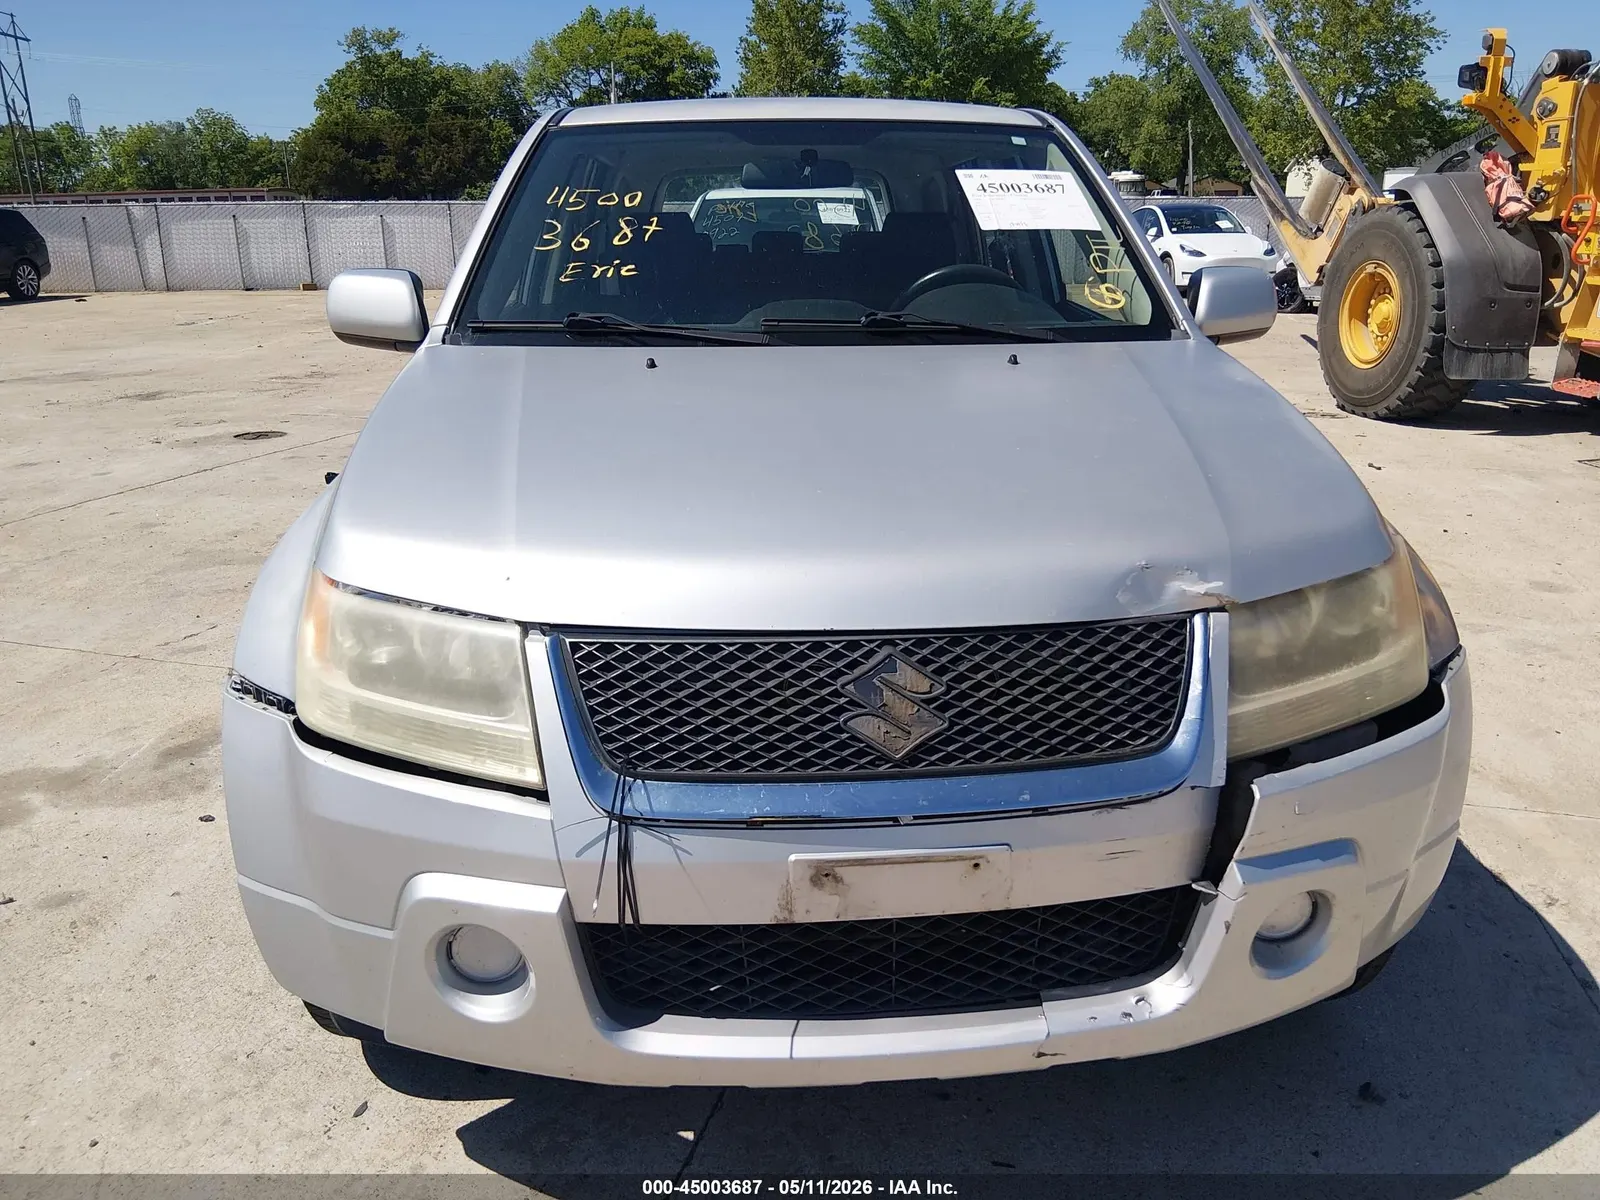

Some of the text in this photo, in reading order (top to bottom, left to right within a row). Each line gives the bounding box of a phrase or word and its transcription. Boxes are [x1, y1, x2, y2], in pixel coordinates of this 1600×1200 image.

[1455, 136, 1472, 149] NOT
[1474, 127, 1496, 140] WAL
[546, 186, 643, 211] 4500
[976, 182, 1065, 195] 45003687
[559, 259, 640, 282] Eric
